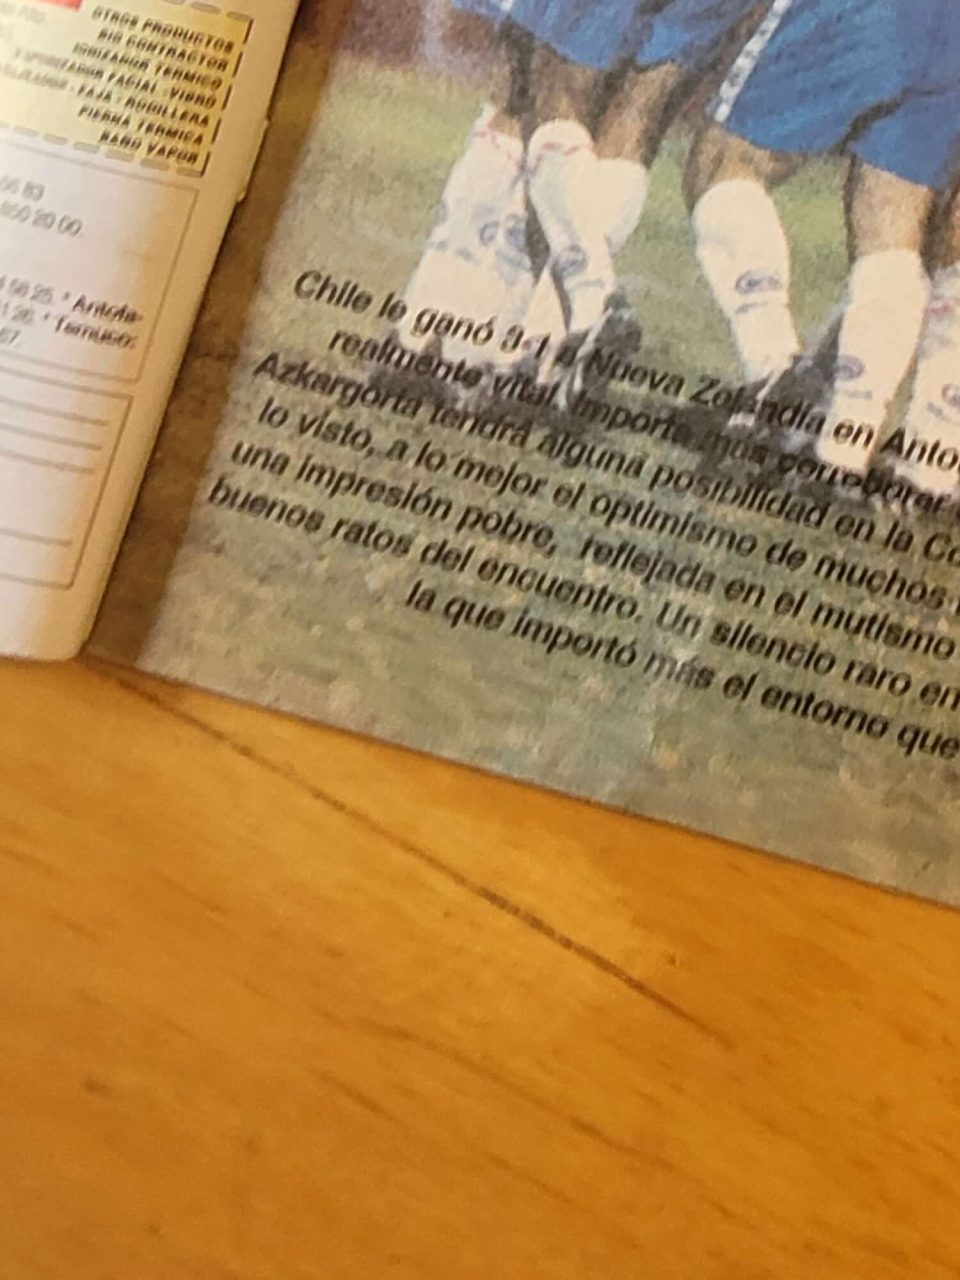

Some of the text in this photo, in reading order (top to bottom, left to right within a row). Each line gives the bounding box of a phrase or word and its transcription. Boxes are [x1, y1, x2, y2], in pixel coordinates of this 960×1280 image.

[147, 142, 199, 165] VAPOR
[252, 351, 421, 418] Azkargorta
[429, 399, 533, 448] tendrá
[536, 430, 648, 479] alguna
[650, 461, 831, 530] posibilidad
[834, 514, 876, 543] en
[883, 520, 914, 553] la
[294, 270, 372, 314] Chile
[378, 292, 407, 321] le
[409, 307, 497, 346] ganó
[500, 324, 550, 359] 3-1
[584, 346, 685, 398] Nueva
[833, 419, 874, 450] en
[328, 329, 484, 390] realmente
[207, 474, 326, 534] buenos
[330, 517, 415, 559] ratos
[419, 539, 476, 574] del
[477, 557, 643, 625] encuentro.
[656, 600, 702, 639] Un
[708, 619, 837, 677] silencio
[842, 658, 912, 698] raro
[230, 439, 291, 477] una
[295, 453, 453, 521] impresión
[455, 502, 557, 559] pobre,
[580, 534, 716, 595] reflejada
[724, 575, 766, 609] en
[773, 589, 808, 620] el
[812, 601, 956, 662] mutismo
[257, 396, 289, 430] lo
[298, 410, 375, 459] visto,
[385, 438, 409, 462] a
[413, 441, 448, 473] lo
[452, 456, 549, 498] mejor
[552, 481, 587, 510] el
[588, 491, 757, 558] optimismo
[765, 538, 808, 571] de
[813, 552, 948, 612] muchos
[405, 579, 438, 613] la
[442, 594, 506, 630] que
[511, 608, 638, 669] importó
[643, 651, 716, 691] más
[722, 672, 759, 701] el
[760, 684, 890, 741] entorno
[896, 722, 960, 761] que
